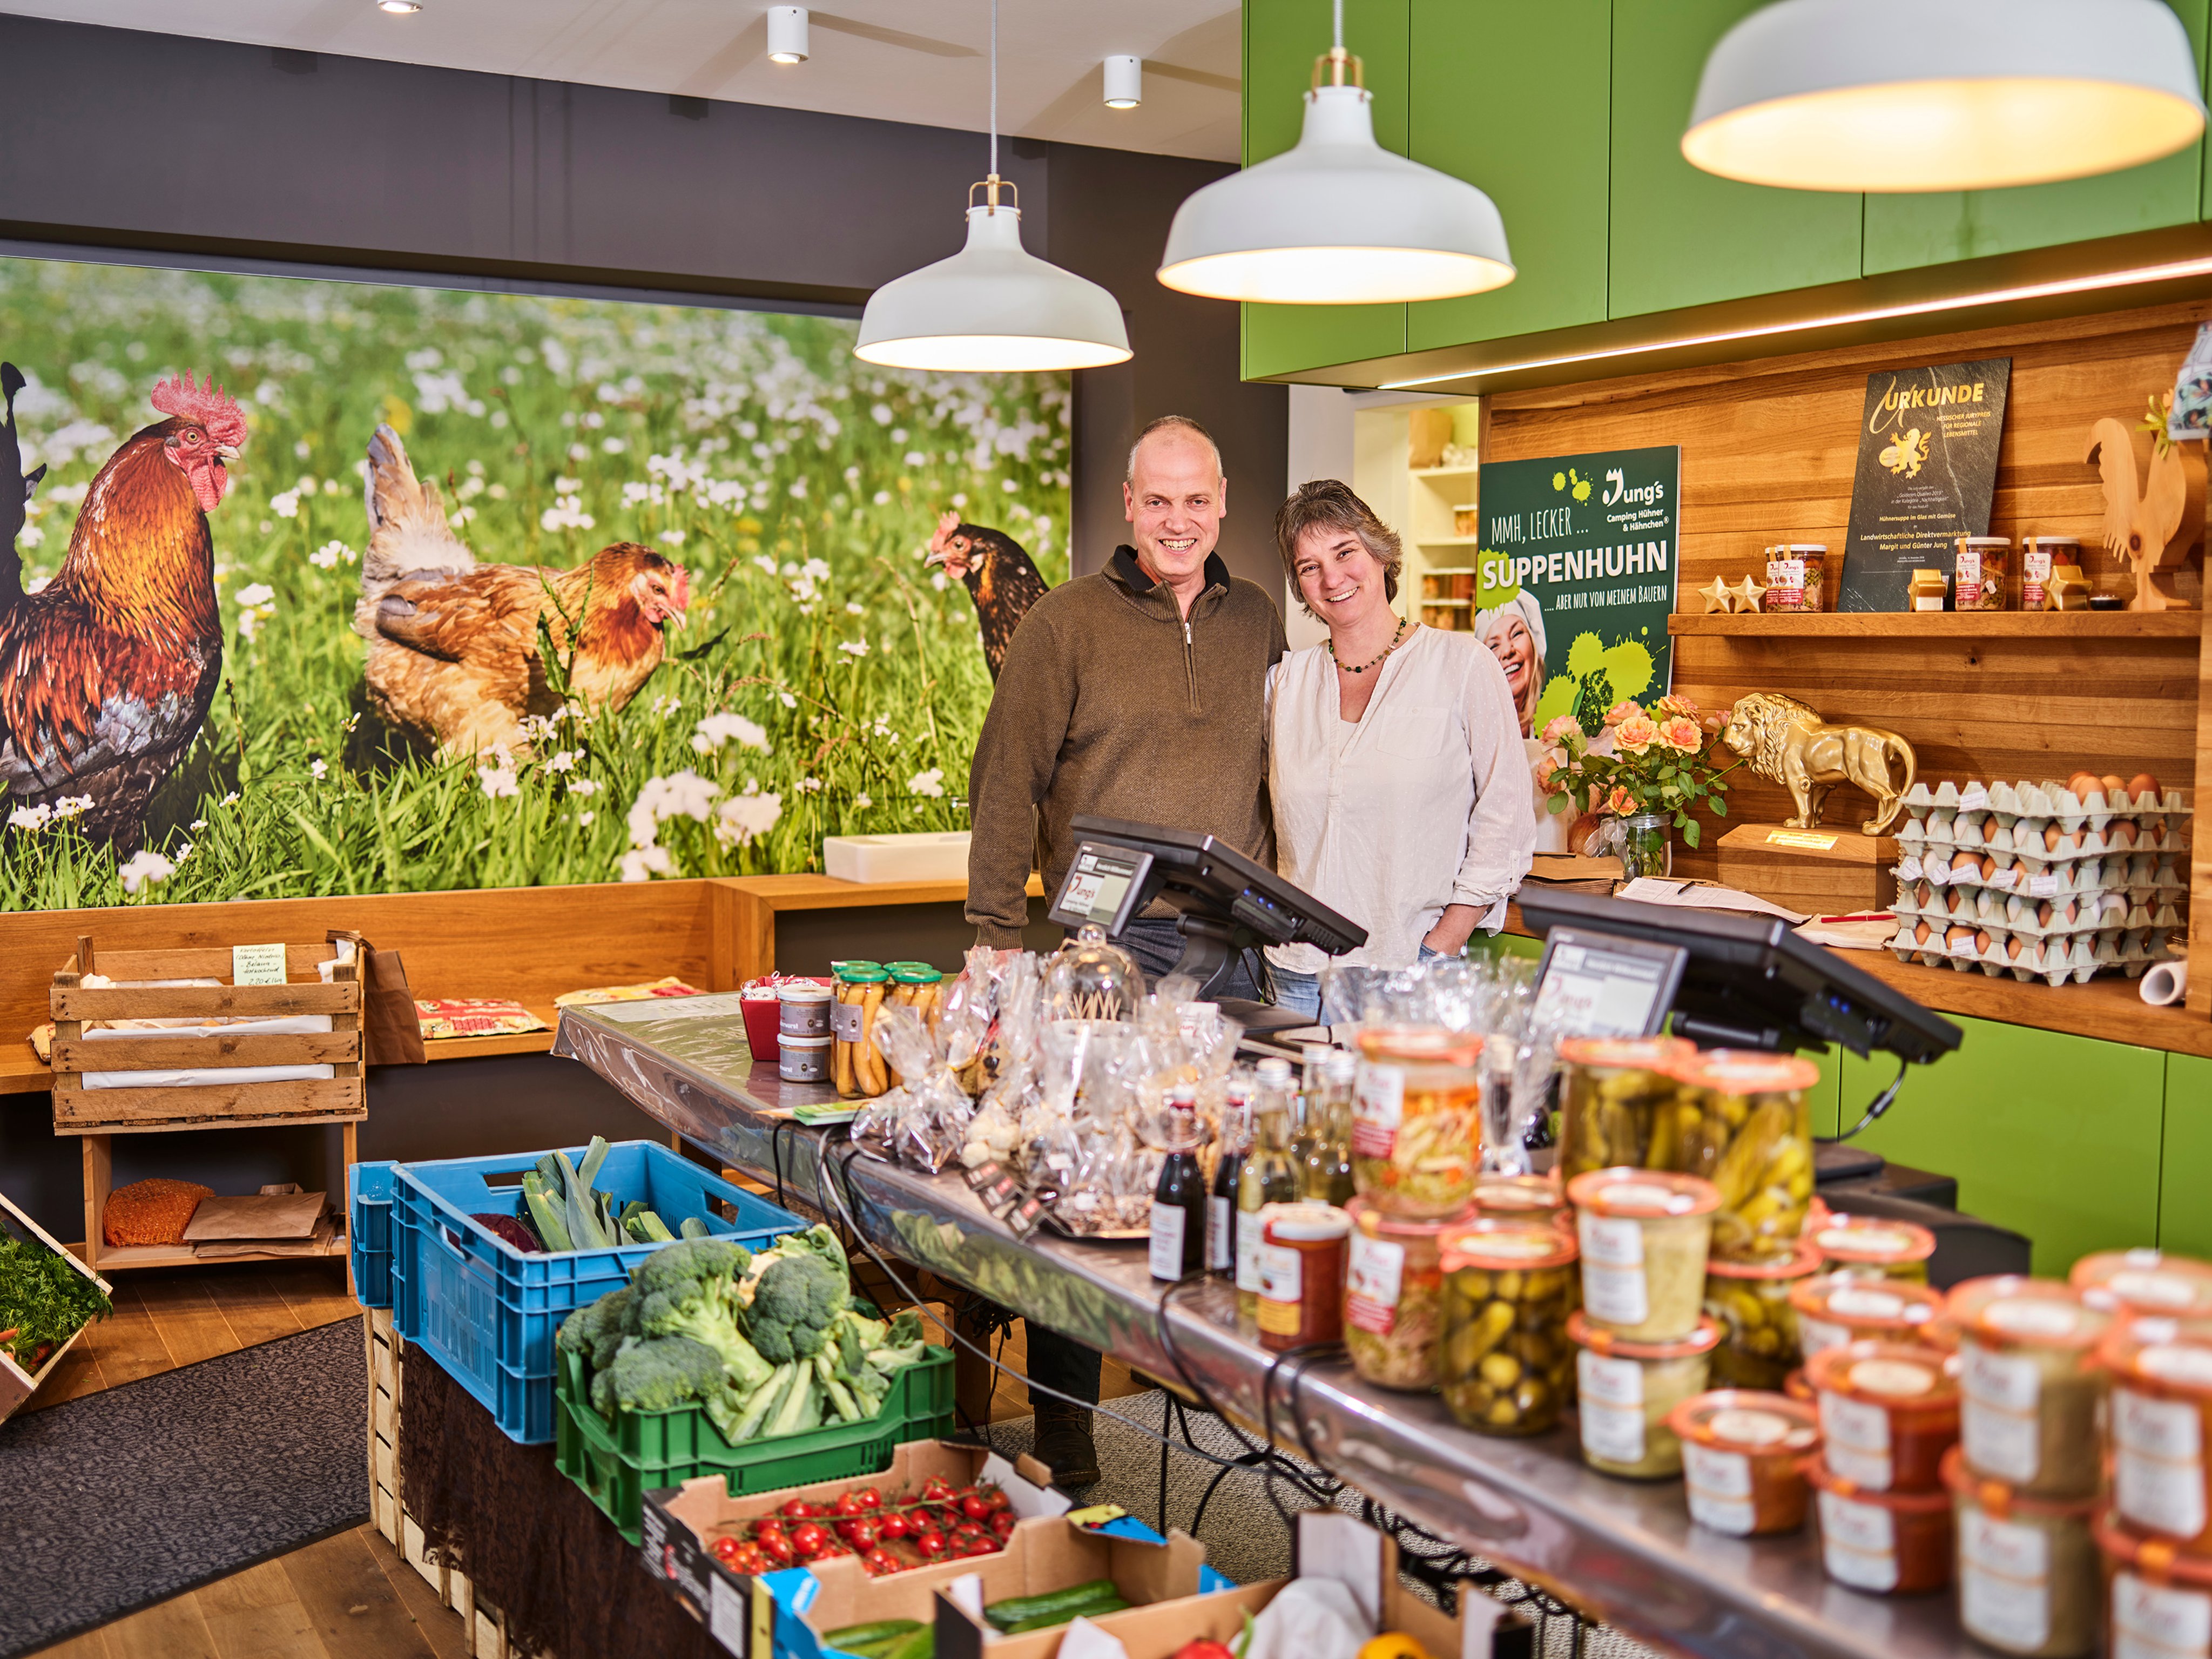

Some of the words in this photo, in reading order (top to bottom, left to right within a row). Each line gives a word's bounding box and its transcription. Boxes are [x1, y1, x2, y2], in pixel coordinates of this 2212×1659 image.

[1885, 383, 1984, 410] URKUNDE
[1966, 411, 1991, 420] JURYPREIS
[1944, 430, 1978, 438] LEBENSMITTEL
[1606, 511, 1637, 523] Camping
[1638, 509, 1664, 518] Hühner
[1492, 514, 1526, 545] MMH,
[1530, 507, 1572, 540] LECKER
[1623, 524, 1629, 532] &
[1860, 532, 1914, 541] Landwirtschaftliche
[1916, 531, 1972, 539] Direktvermarktung
[1933, 542, 1948, 550] Jung
[1482, 539, 1667, 590] SUPPENHUHN
[1555, 594, 1572, 610] ABER
[1574, 592, 1588, 609] NUR
[1589, 591, 1606, 606] VON
[1607, 588, 1636, 605] MEINEM
[1638, 585, 1667, 603] BAUERN
